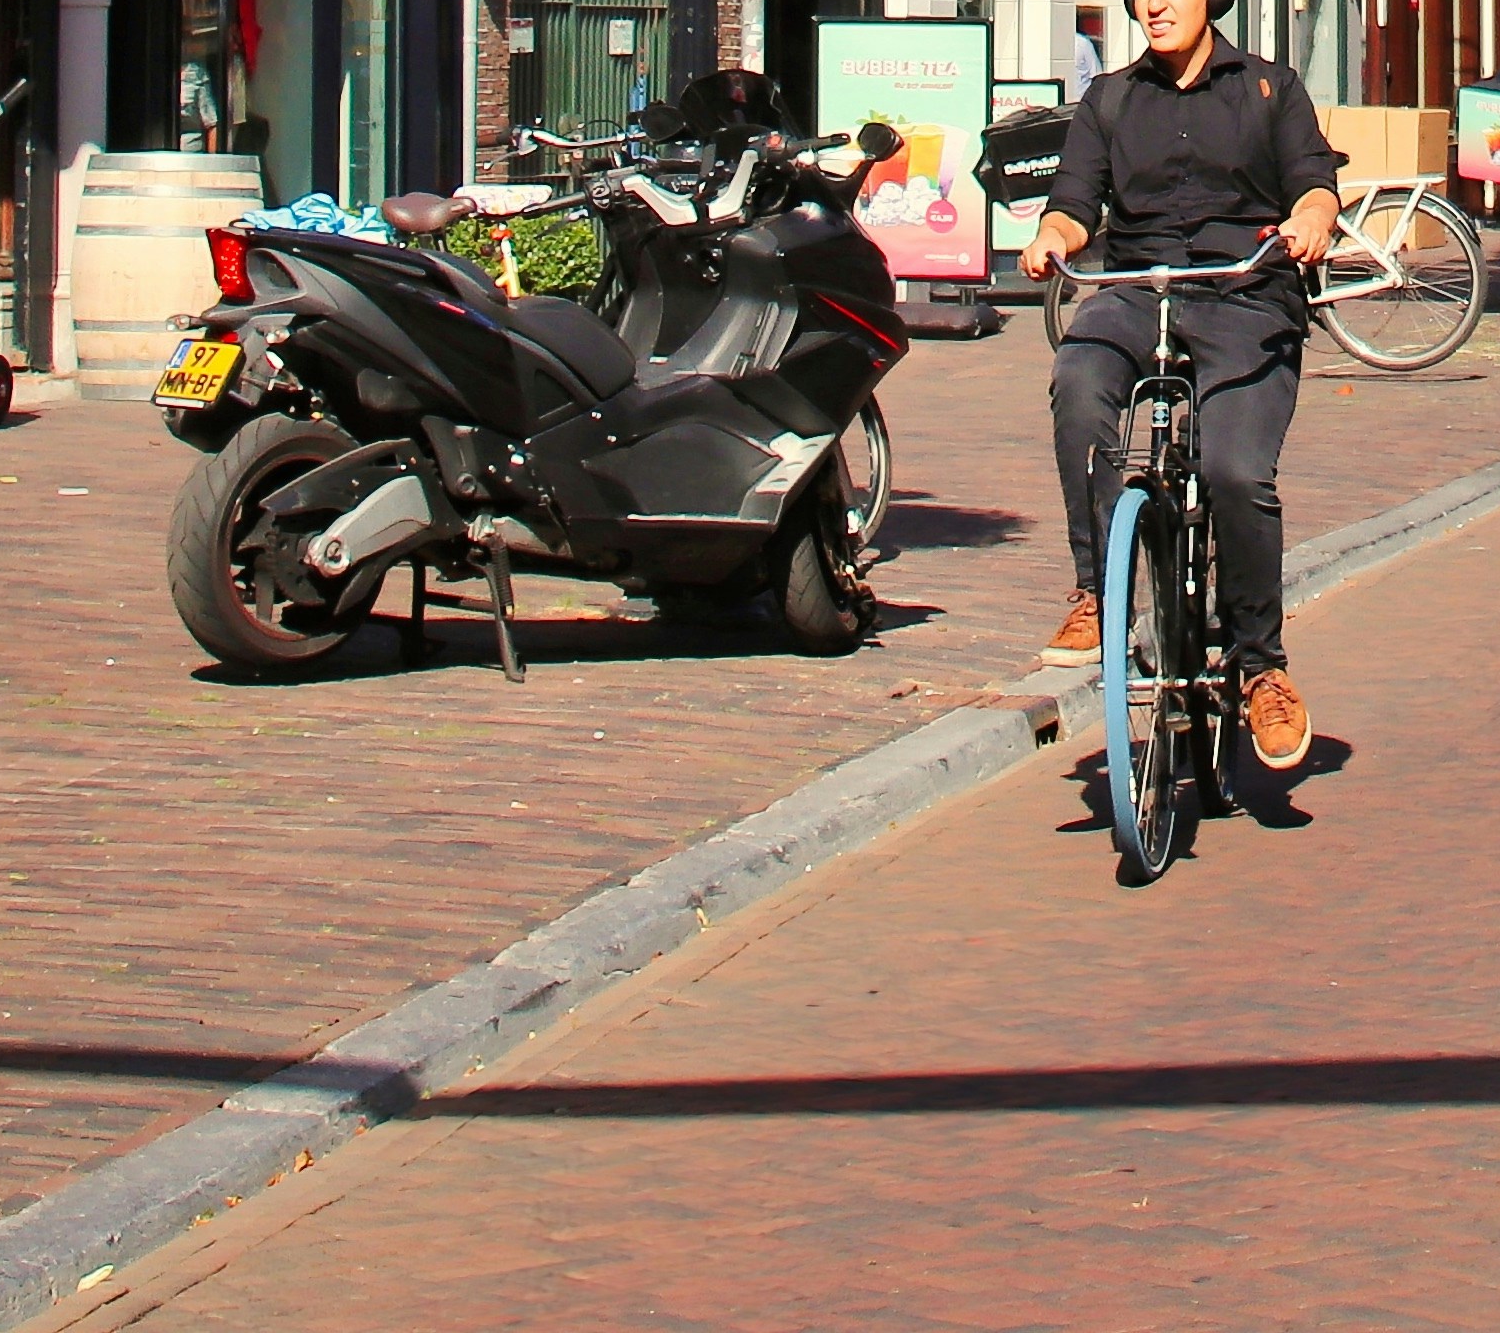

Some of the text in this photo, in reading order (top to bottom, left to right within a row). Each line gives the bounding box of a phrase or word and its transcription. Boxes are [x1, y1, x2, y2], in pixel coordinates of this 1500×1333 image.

[842, 59, 961, 76] BUBBLE TEA
[191, 346, 220, 367] 97
[160, 371, 222, 396] MN-BF
